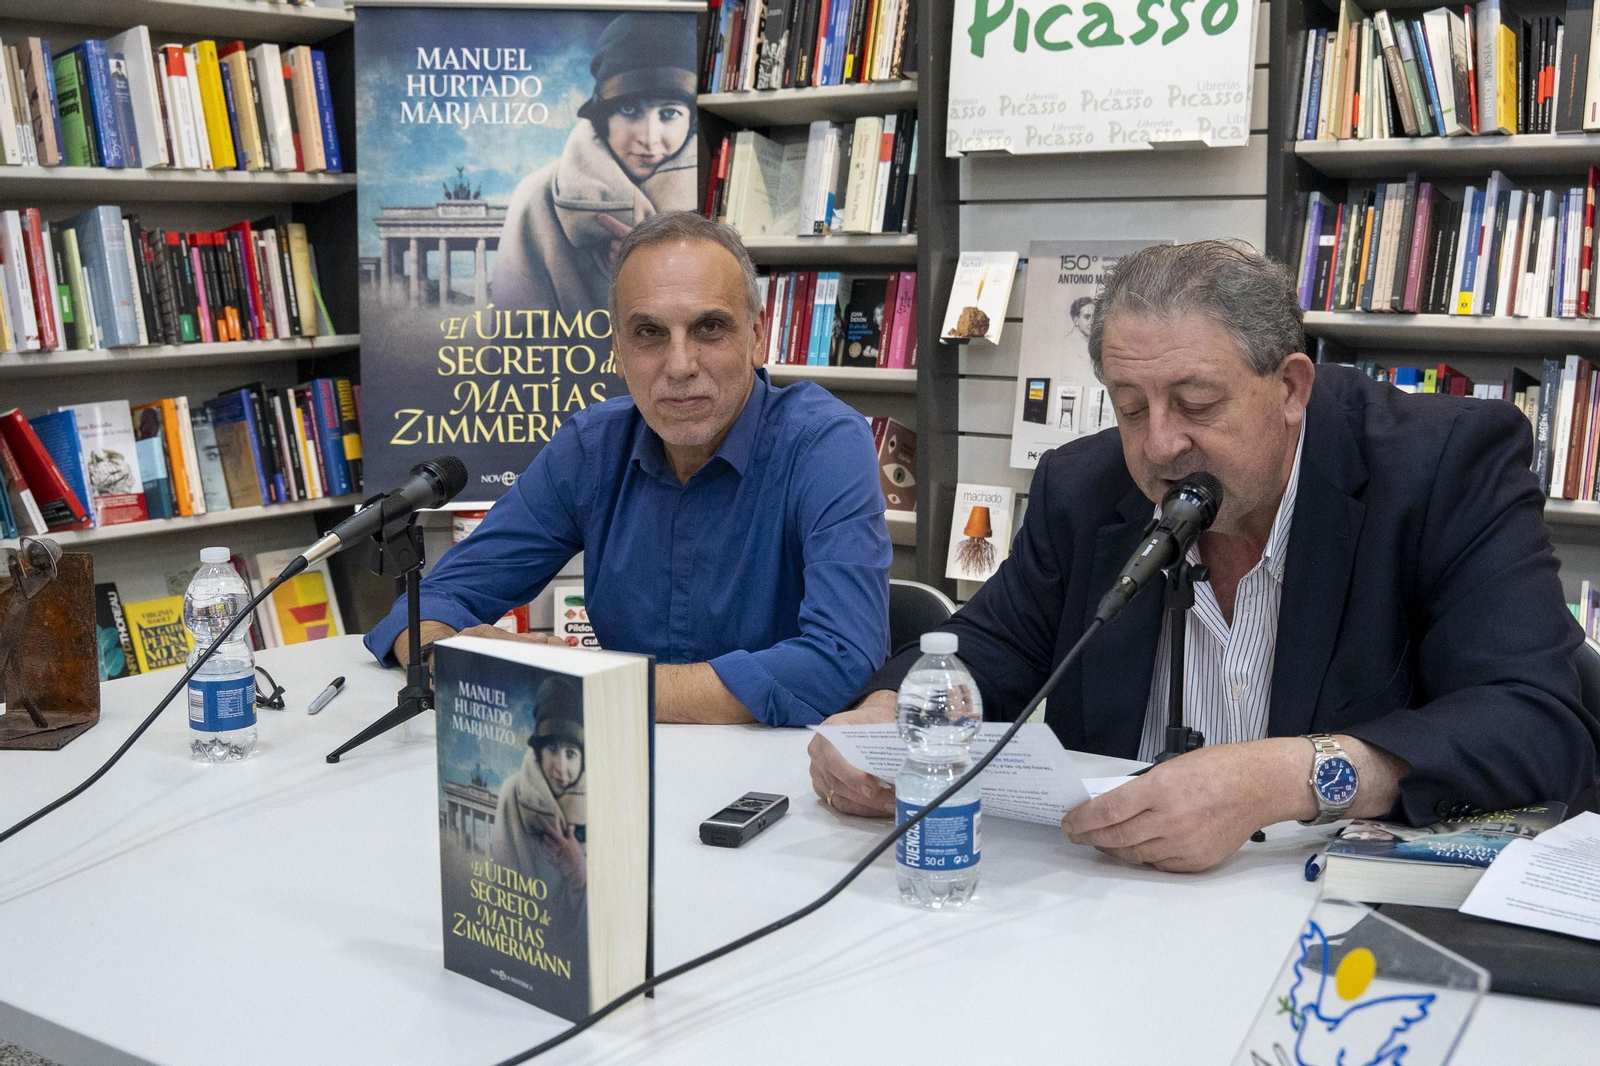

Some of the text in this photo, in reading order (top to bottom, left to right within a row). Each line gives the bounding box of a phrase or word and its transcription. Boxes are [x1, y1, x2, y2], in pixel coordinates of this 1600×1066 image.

[968, 0, 1238, 58] Picasso
[417, 48, 532, 70] MANUEL
[1483, 43, 1492, 78] POESÍA
[407, 75, 542, 98] HURTADO
[1025, 93, 1058, 102] Librerías
[1109, 88, 1144, 96] Librerías
[1168, 85, 1244, 108] Picasso
[1197, 81, 1240, 91] Librerías
[950, 97, 978, 106] ibrerías
[1000, 95, 1067, 116] Picasso
[1081, 89, 1152, 113] Picasso
[400, 102, 549, 129] MARJALIZO
[1052, 123, 1086, 132] Librerías
[1137, 119, 1173, 128] Librerías
[949, 129, 1012, 150] Picasso
[972, 127, 1004, 137] Librerías
[1026, 125, 1094, 148] Picasso
[1109, 120, 1181, 144] Picasso
[1058, 274, 1093, 284] ANTONIO
[440, 303, 612, 340] El ÚLTIMO
[438, 345, 596, 376] SECRETO
[450, 377, 606, 415] MATÍAS
[390, 408, 562, 444] ZIMMER
[964, 492, 1002, 503] machado
[108, 591, 129, 644] THOREAU
[458, 681, 508, 708] MANUEL
[455, 698, 513, 726] HURTADO
[452, 715, 516, 746] MARJALIZO
[925, 857, 944, 866] 50 cl
[471, 858, 548, 900] El ÚLTIMO
[470, 879, 552, 926] SECRETO de
[476, 904, 545, 949] MATÍAS
[452, 912, 571, 980] ZIMMERMANN
